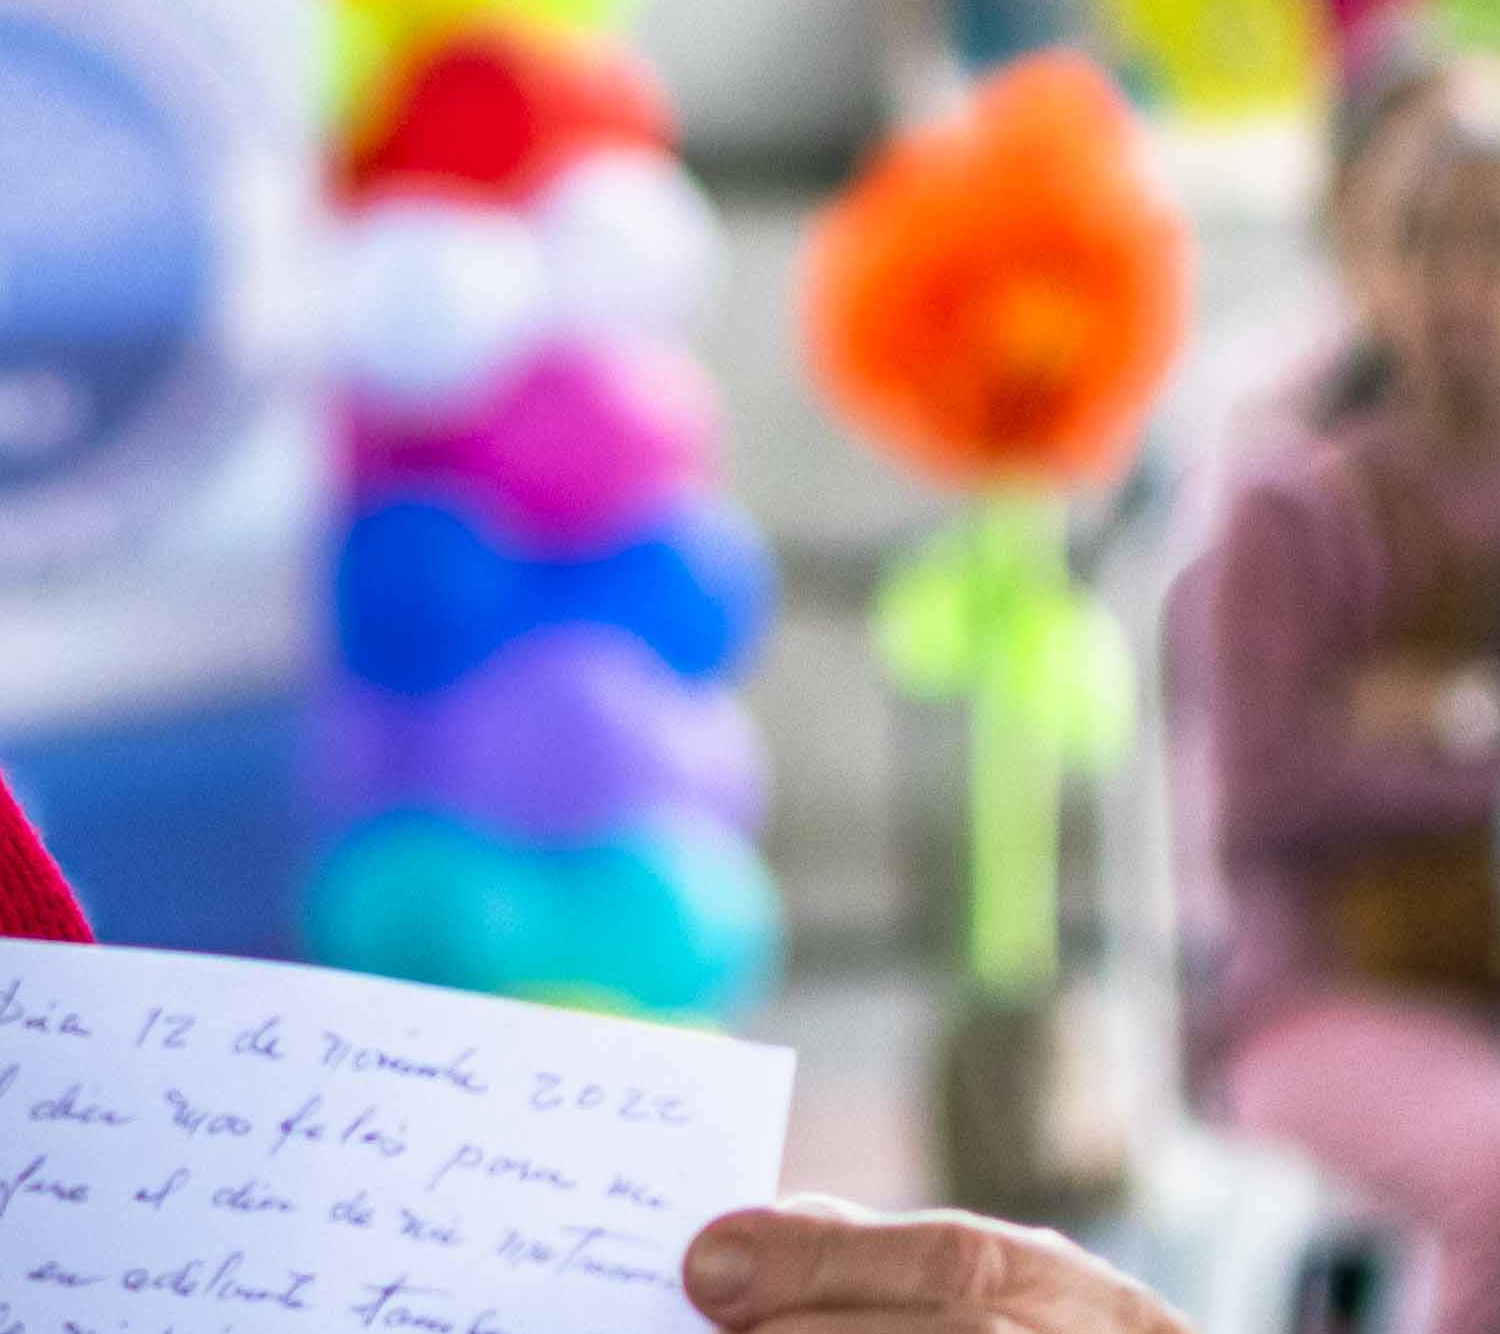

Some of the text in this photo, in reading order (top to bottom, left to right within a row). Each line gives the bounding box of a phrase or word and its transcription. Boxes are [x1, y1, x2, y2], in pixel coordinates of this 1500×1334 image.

[134, 1006, 197, 1049] 12
[232, 1015, 284, 1060] de
[529, 1071, 692, 1125] 2022
[328, 1189, 375, 1228] de
